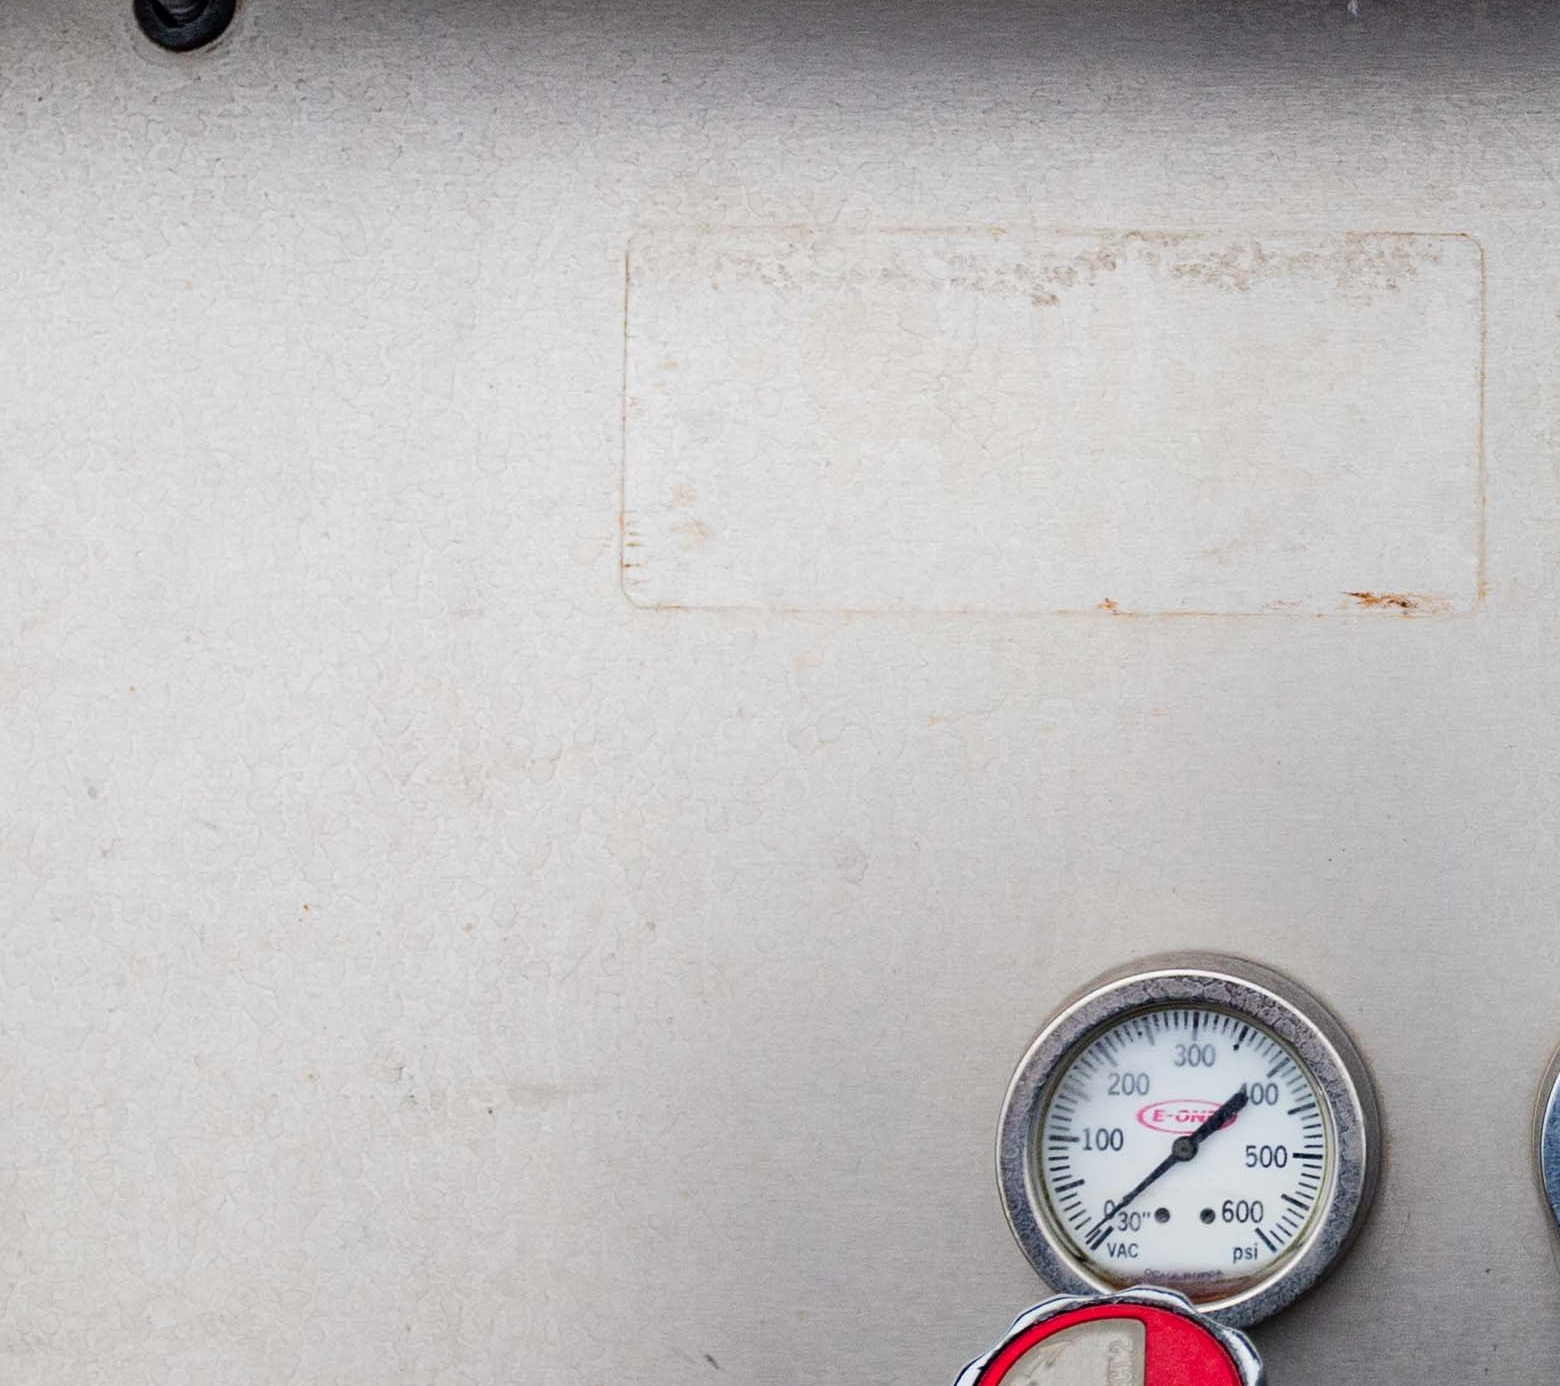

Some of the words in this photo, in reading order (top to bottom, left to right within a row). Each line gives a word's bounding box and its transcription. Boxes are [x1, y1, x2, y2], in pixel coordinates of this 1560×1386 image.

[1174, 1043, 1217, 1068] 300
[1107, 1072, 1151, 1097] 200
[1083, 1127, 1124, 1152] 100
[1244, 1144, 1288, 1169] 500
[1220, 1199, 1264, 1224] 600
[1107, 1242, 1139, 1258] VAC
[1232, 1243, 1259, 1263] psi
